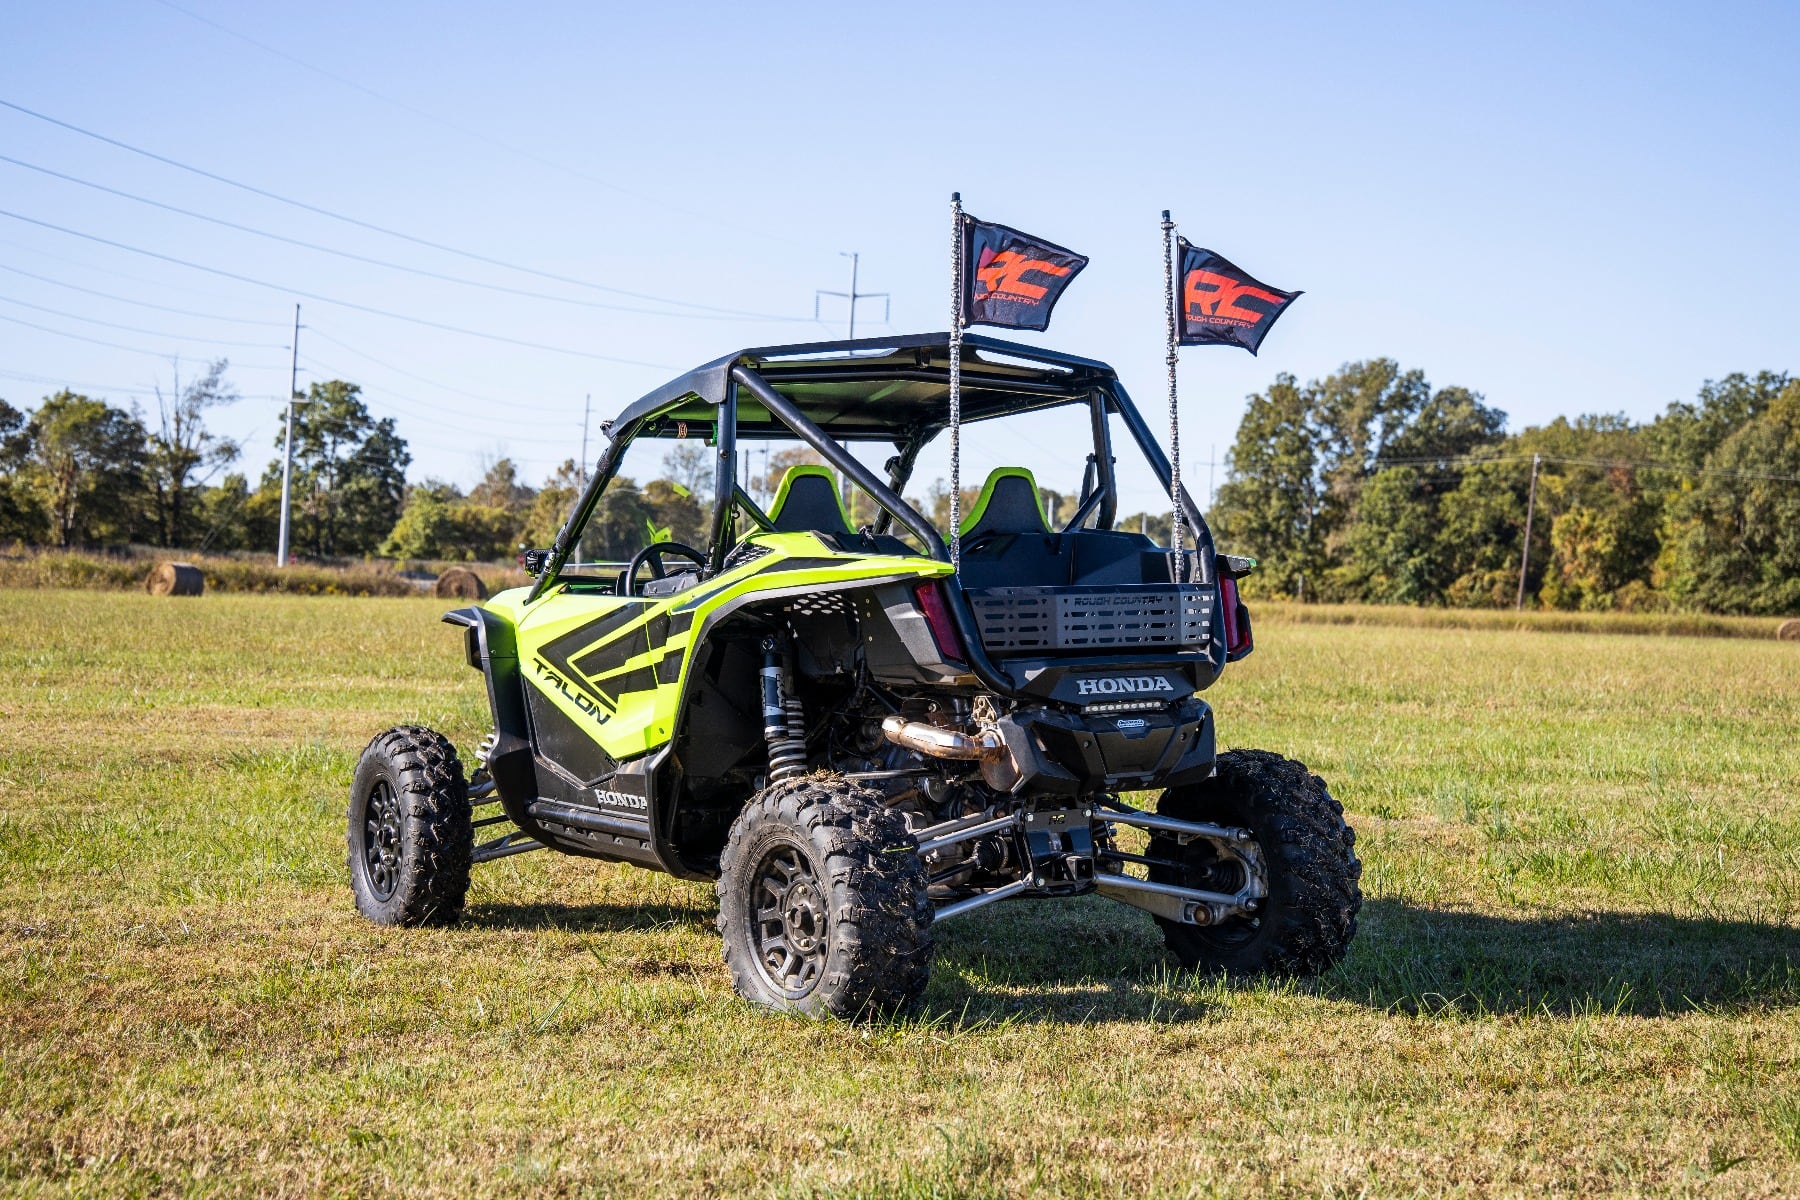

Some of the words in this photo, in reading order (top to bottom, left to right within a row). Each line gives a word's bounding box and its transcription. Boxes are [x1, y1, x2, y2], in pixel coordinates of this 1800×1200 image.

[1184, 269, 1285, 323] RC
[1209, 317, 1255, 329] COUNTRY
[1074, 597, 1110, 606] ROUGH
[1113, 595, 1162, 605] COUNTRY
[532, 657, 611, 726] TALON
[1076, 676, 1174, 695] HONDA
[594, 789, 648, 810] HONDA
